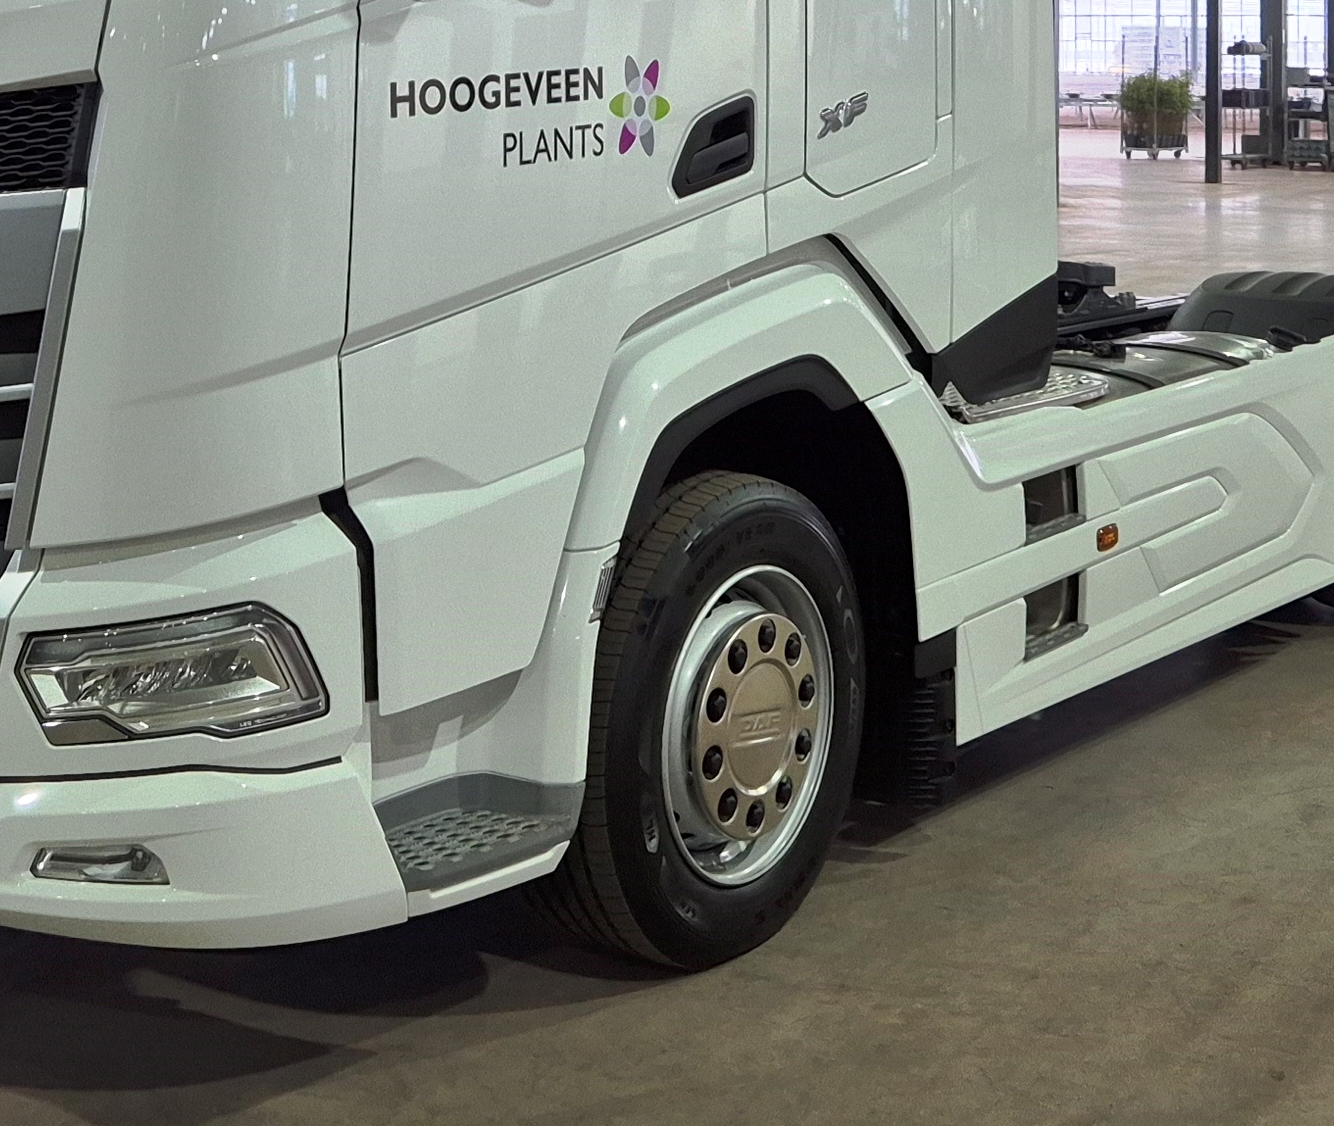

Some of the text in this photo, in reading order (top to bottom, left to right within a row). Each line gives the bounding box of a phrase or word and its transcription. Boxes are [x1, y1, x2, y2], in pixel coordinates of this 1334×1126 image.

[389, 66, 604, 118] HOOGEVEEN
[817, 91, 869, 139] XF
[502, 123, 604, 167] PLANTS
